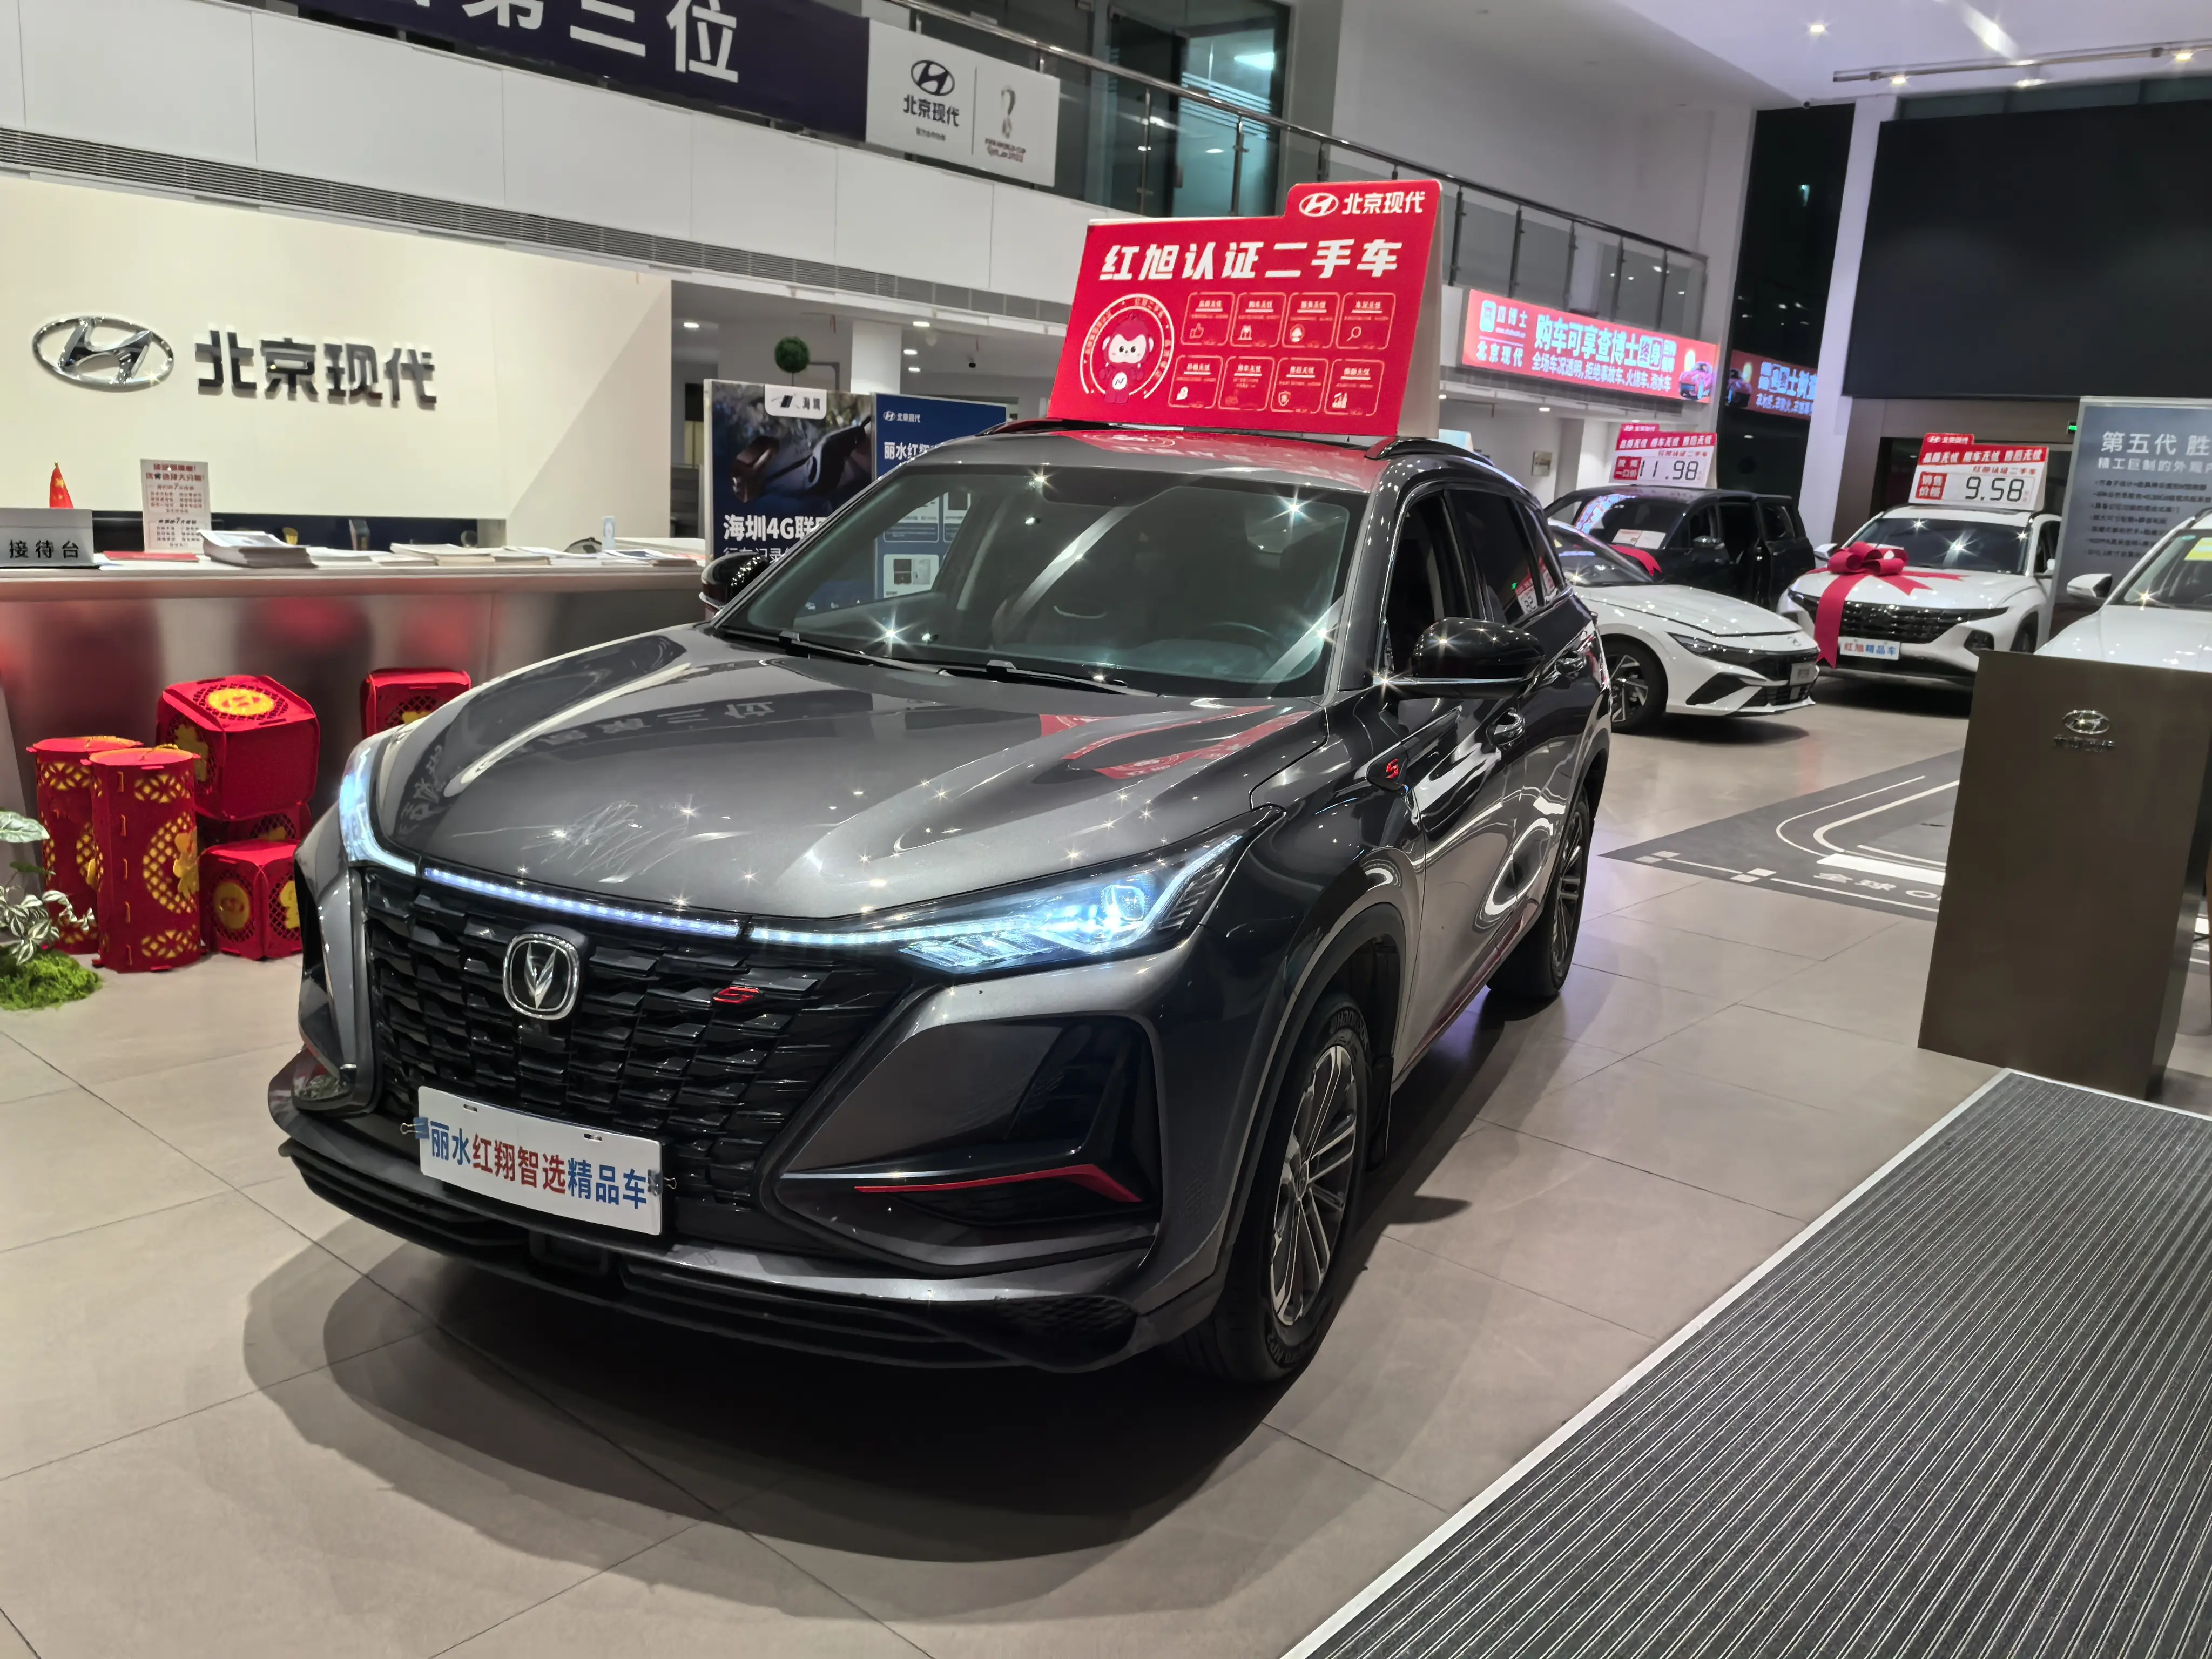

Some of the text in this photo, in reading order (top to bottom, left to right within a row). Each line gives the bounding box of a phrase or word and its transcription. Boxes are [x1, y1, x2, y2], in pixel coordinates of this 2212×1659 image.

[903, 94, 960, 127] 北京现代
[1342, 191, 1426, 215] 北京现代
[1099, 239, 1402, 280] 红旭认证二手车
[194, 327, 438, 407] 北京现代
[1476, 340, 1523, 368] 北京现代
[884, 442, 936, 459] 丽水红
[2100, 431, 2211, 456] 第五代 胜
[1640, 460, 1699, 481] 11.98
[1965, 476, 2025, 502] 9.58
[9, 539, 79, 559] 接待台
[430, 1120, 648, 1210] 丽水红翔智选精品车
